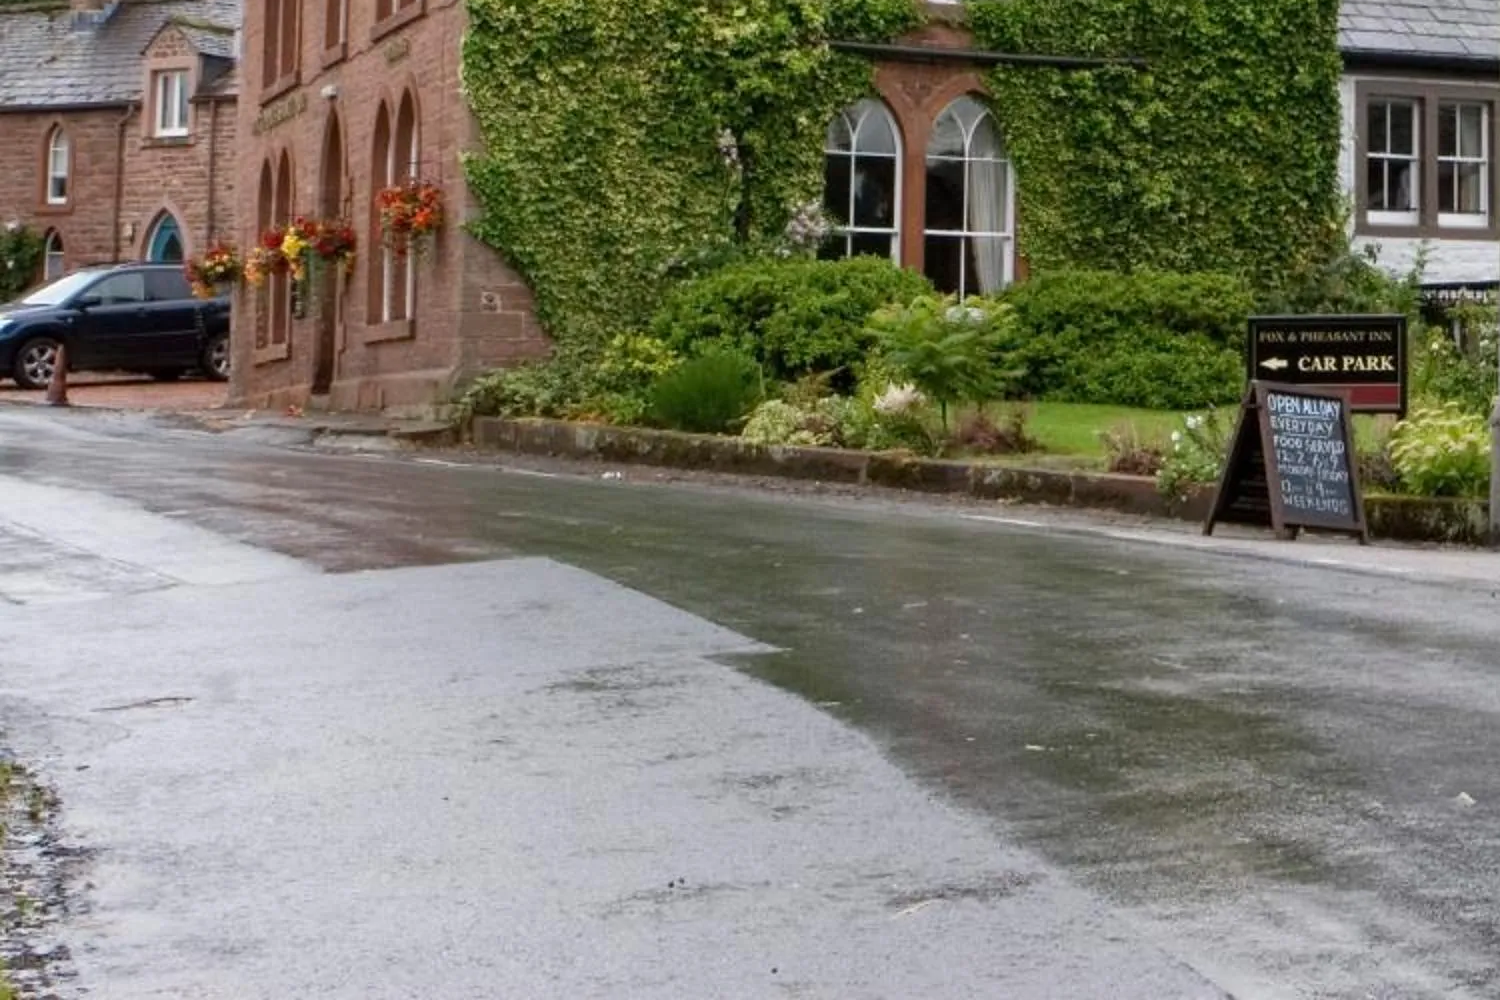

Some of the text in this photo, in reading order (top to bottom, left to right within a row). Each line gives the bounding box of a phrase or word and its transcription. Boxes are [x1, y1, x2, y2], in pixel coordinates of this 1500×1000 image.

[1259, 331, 1392, 342] FOX & PHEASANT INN
[1297, 355, 1395, 371] CAR PARK
[1267, 393, 1342, 420] OPEN ALL DAY
[1273, 435, 1345, 456] FOOD SERVED
